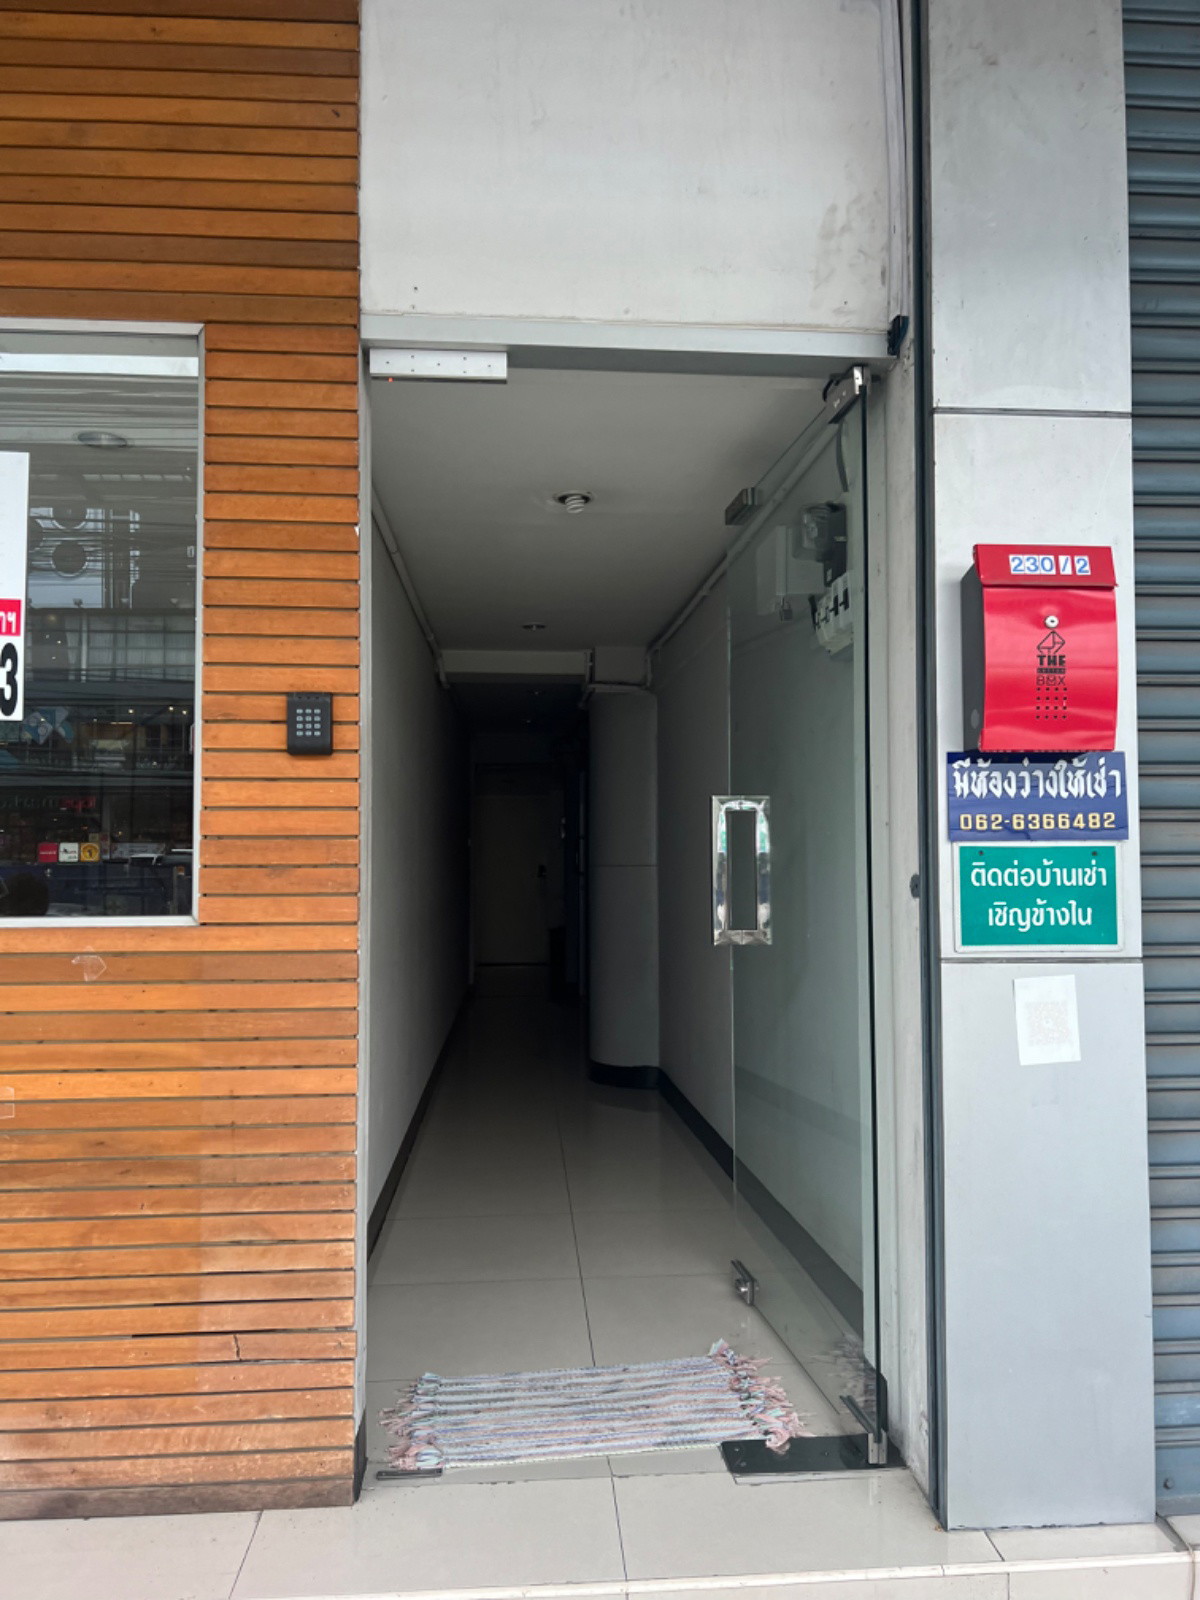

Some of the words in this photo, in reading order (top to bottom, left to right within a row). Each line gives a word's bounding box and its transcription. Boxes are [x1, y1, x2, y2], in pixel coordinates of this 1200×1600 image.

[1010, 556, 1090, 574] 230/2
[1036, 654, 1066, 667] THE
[952, 756, 1122, 799] มีห้องว่างให้เช่า
[959, 811, 1117, 831] 062-6366482
[970, 857, 1107, 887] ติดต่อบ้านเช่า
[987, 898, 1093, 933] เชิญข้างใน
